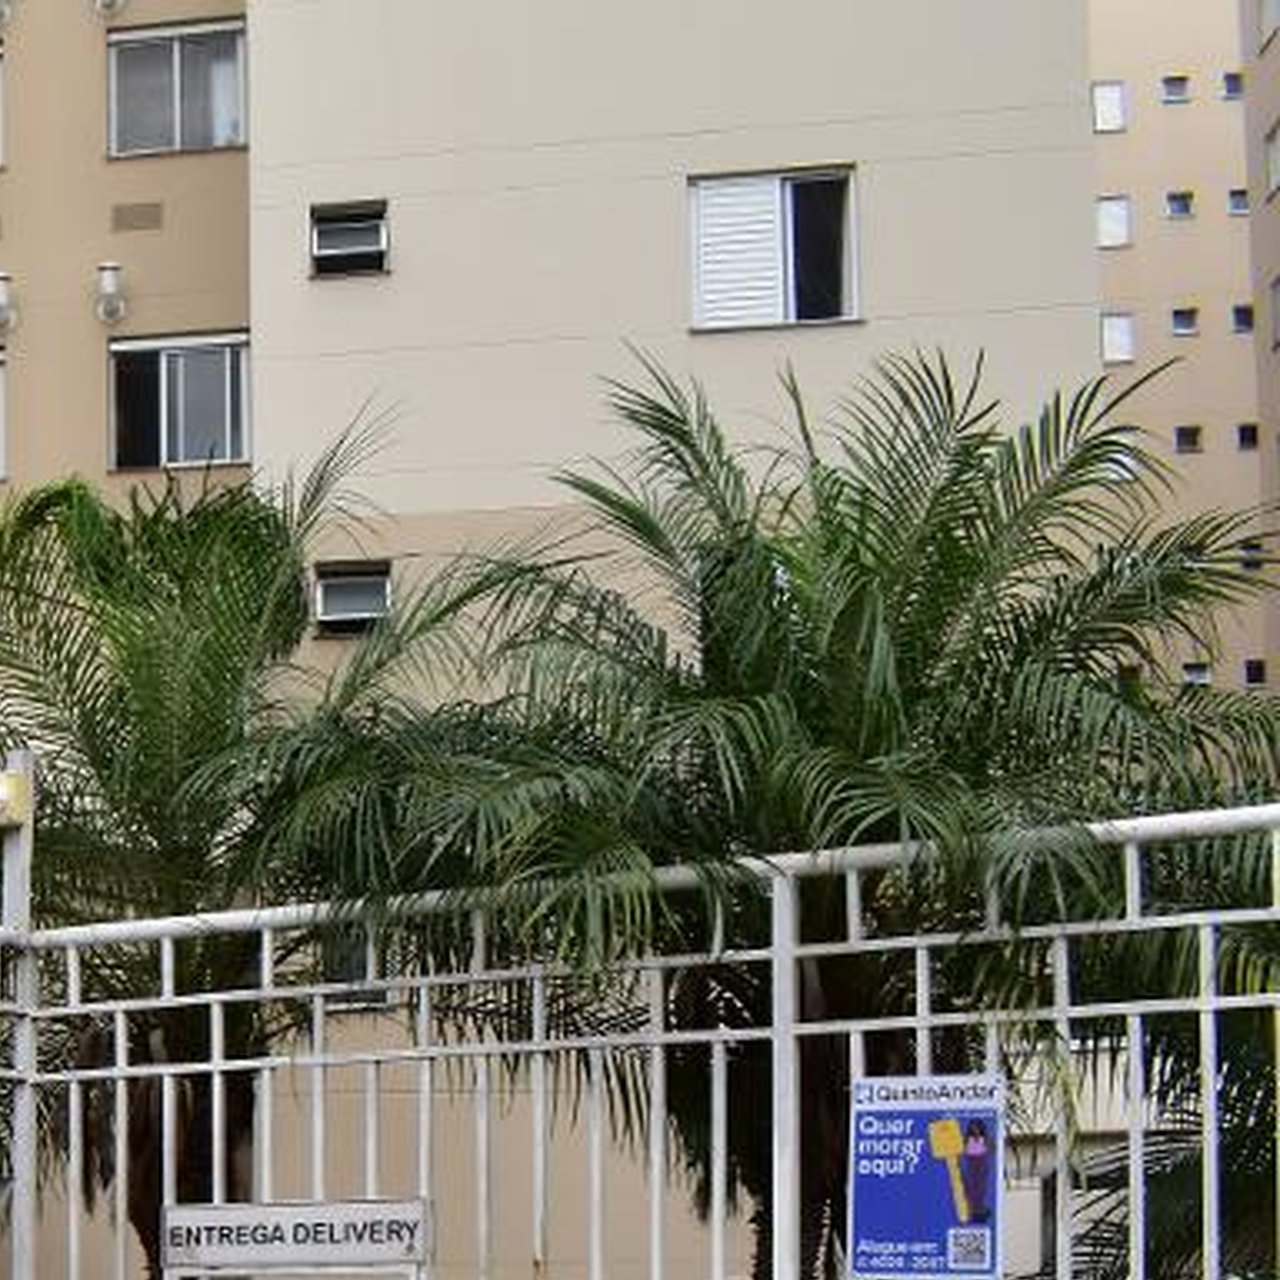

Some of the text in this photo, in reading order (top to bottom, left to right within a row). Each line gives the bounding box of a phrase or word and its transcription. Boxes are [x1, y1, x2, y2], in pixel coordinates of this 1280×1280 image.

[858, 1115, 914, 1136] Quer
[858, 1138, 925, 1155] morar
[857, 1154, 920, 1178] aqui?
[168, 1219, 420, 1248] ENTREGA DELIVERY
